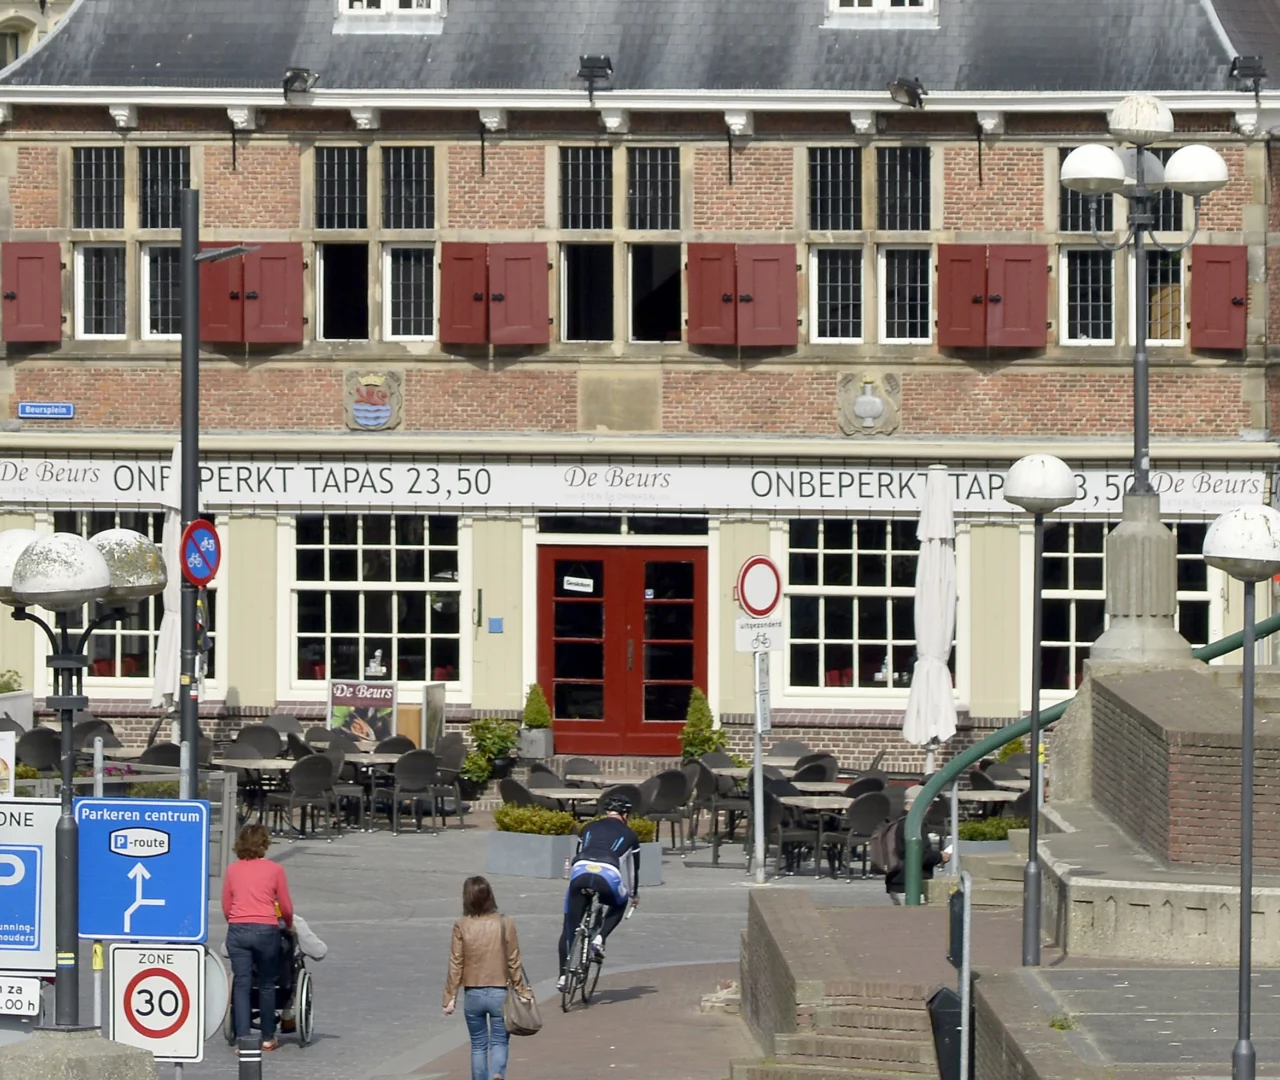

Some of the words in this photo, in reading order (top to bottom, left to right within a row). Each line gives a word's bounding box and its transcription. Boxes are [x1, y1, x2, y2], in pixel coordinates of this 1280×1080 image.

[25, 405, 67, 415] Beursplein
[36, 461, 100, 482] Beurs
[564, 465, 598, 487] De
[605, 465, 671, 488] Beurs
[114, 464, 294, 493] ONPERKT
[304, 466, 394, 494] TAPAS
[406, 467, 492, 500] 23,50
[948, 473, 1005, 500] TAP
[1074, 474, 1136, 507] 3,5
[1151, 471, 1185, 493] De
[1192, 471, 1260, 494] Beurs
[740, 621, 782, 630] uitgezonderd
[333, 683, 353, 697] De
[356, 684, 393, 699] Beurs
[81, 808, 140, 820] Parkeren
[144, 810, 200, 822] centrum
[138, 953, 174, 965] ZONE
[7, 985, 23, 995] za
[27, 1001, 35, 1012] h
[135, 989, 179, 1017] 30
